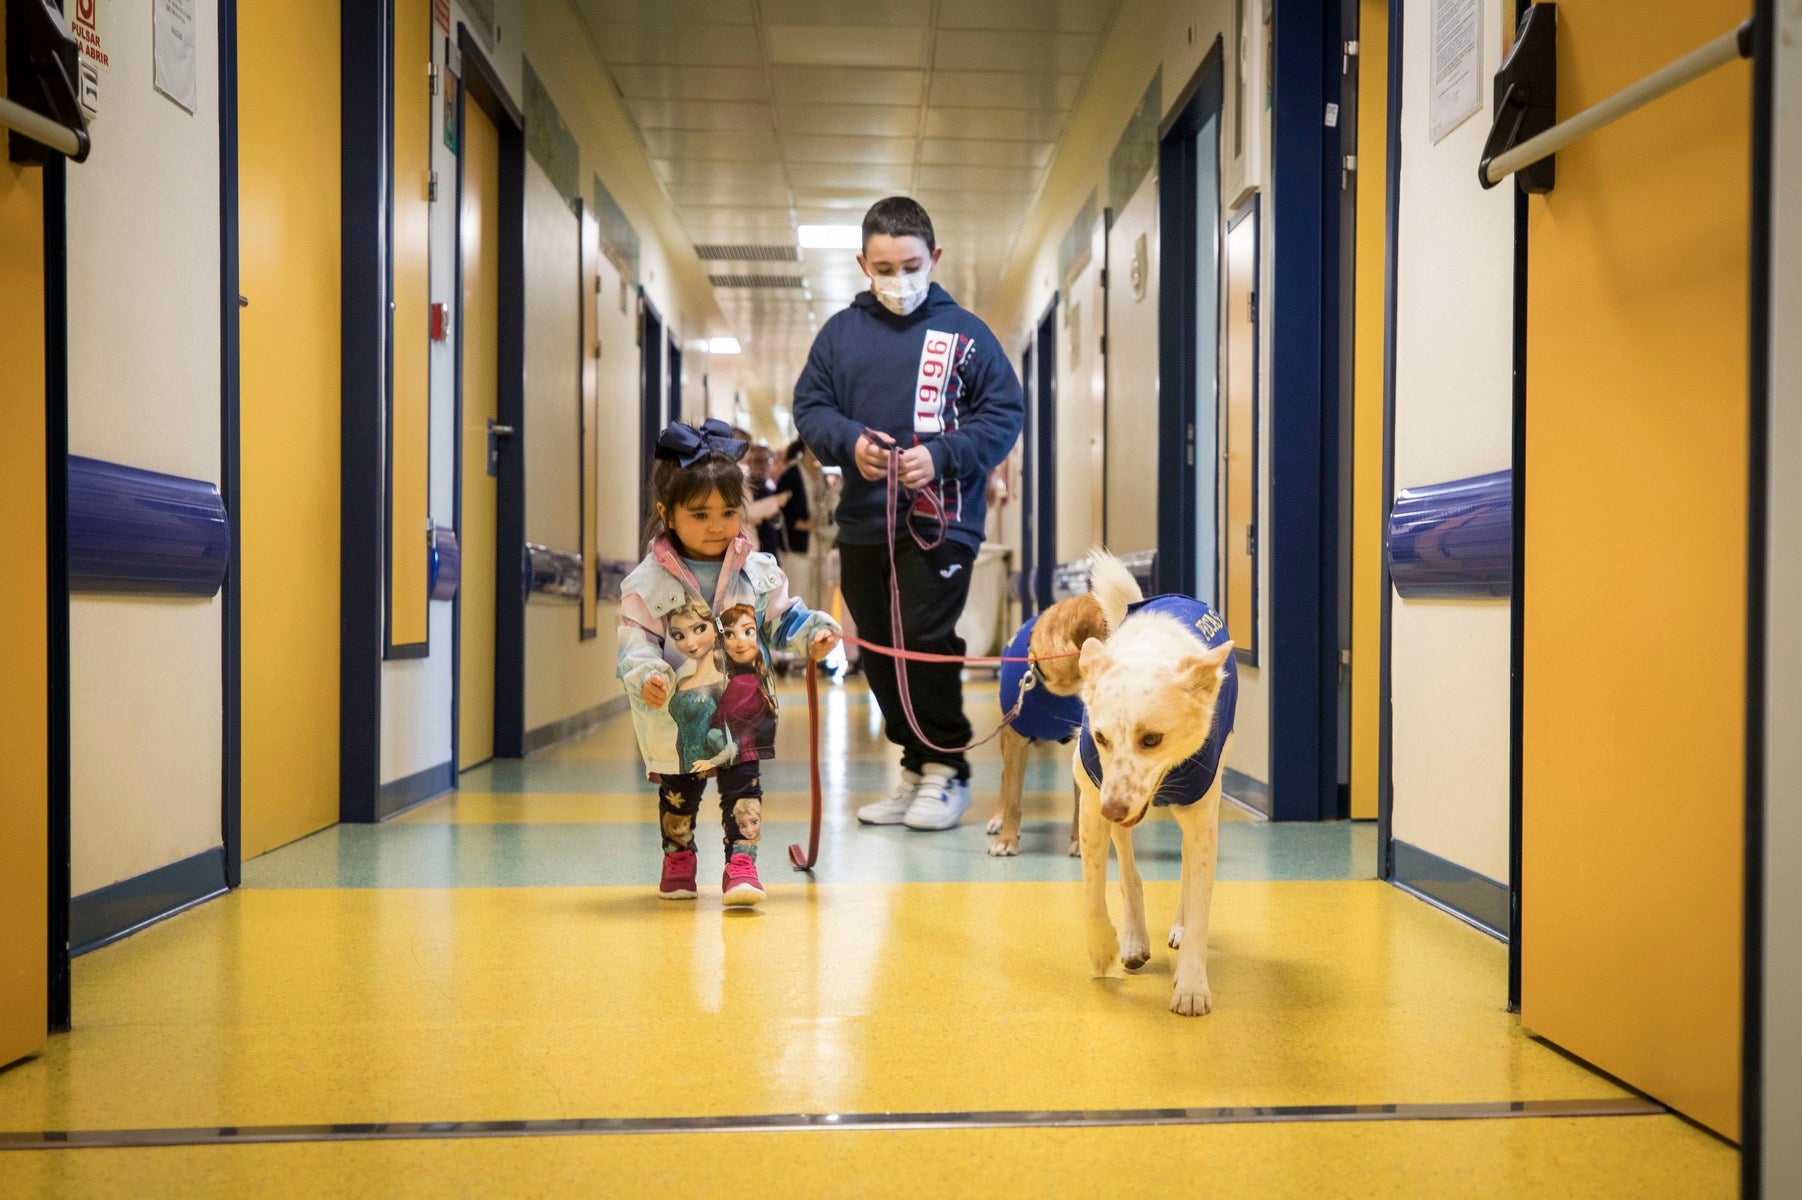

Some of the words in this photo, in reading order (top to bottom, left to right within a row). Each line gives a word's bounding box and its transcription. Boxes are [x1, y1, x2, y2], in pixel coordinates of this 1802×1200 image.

[71, 21, 101, 48] PULSAR
[85, 45, 109, 67] ABRIR
[917, 340, 948, 421] 1996
